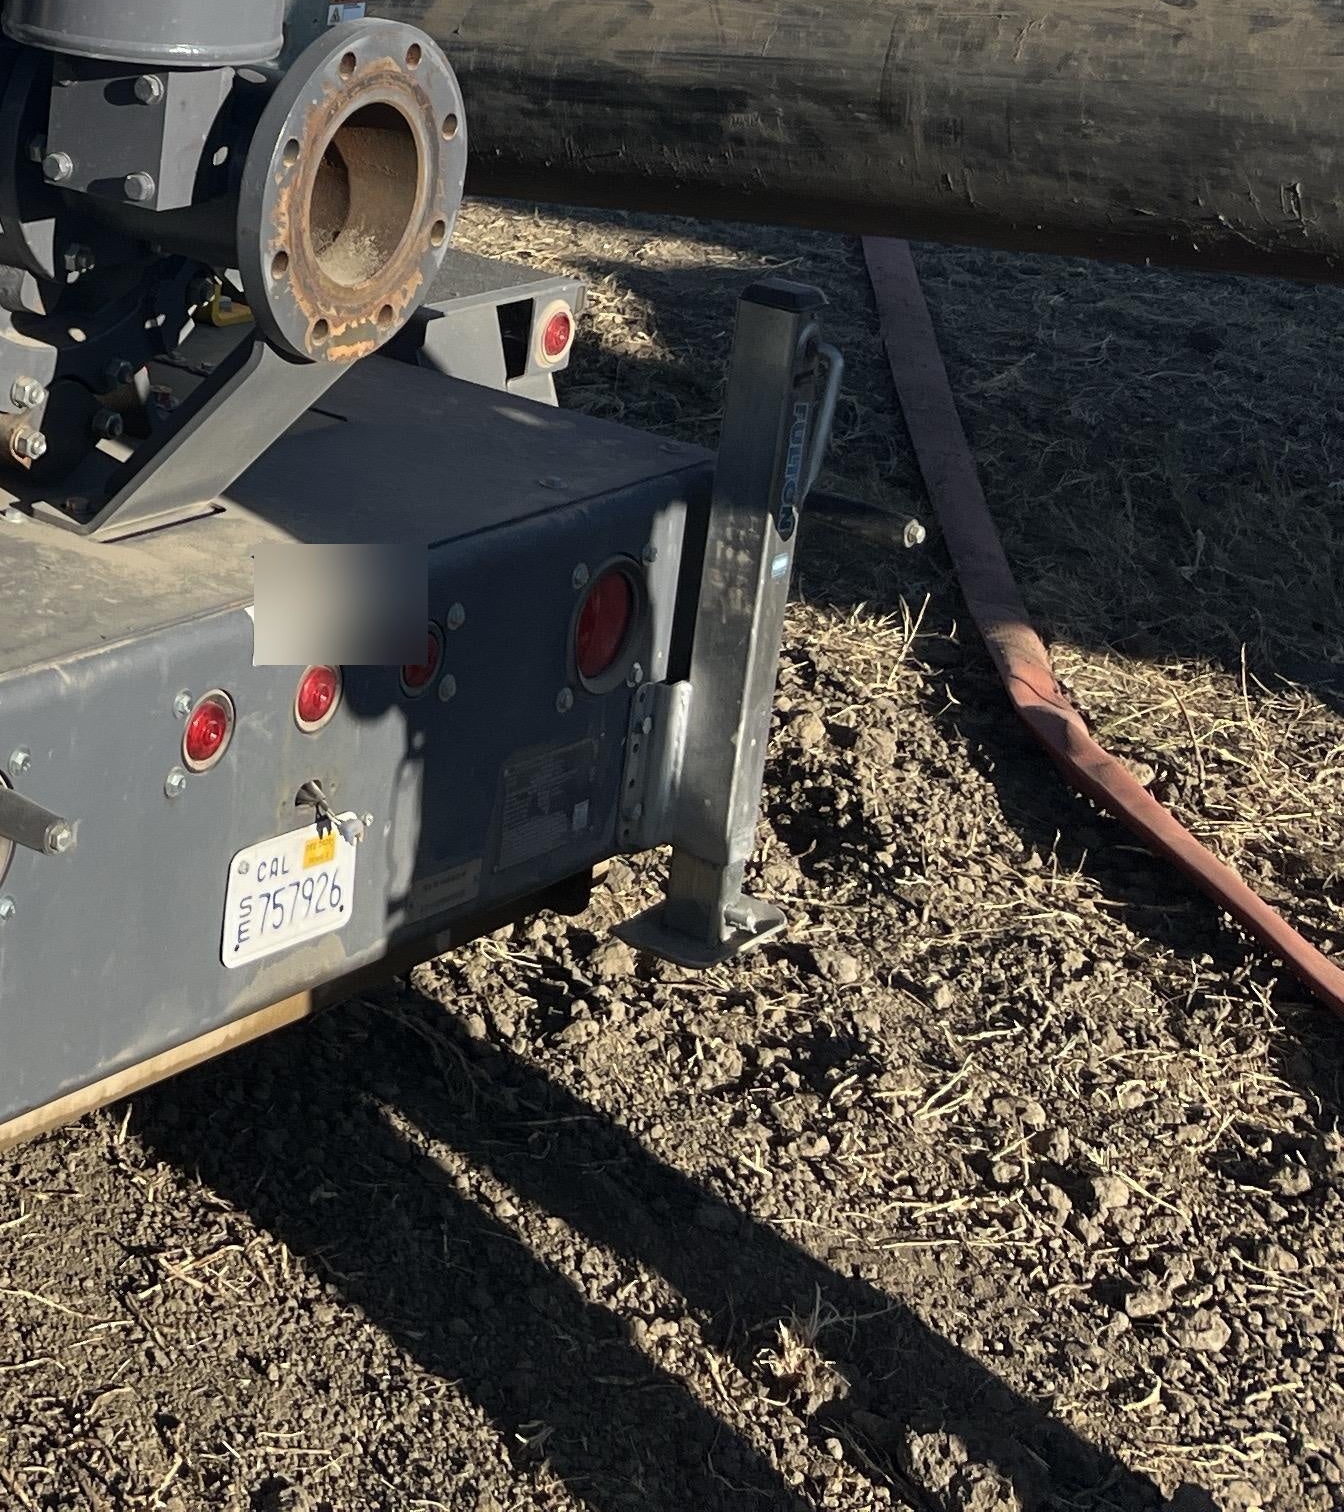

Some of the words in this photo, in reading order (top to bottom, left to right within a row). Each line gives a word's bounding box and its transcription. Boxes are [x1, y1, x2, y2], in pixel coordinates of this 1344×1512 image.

[778, 401, 809, 533] FULTON
[256, 854, 289, 882] CAL
[258, 866, 342, 935] 757926
